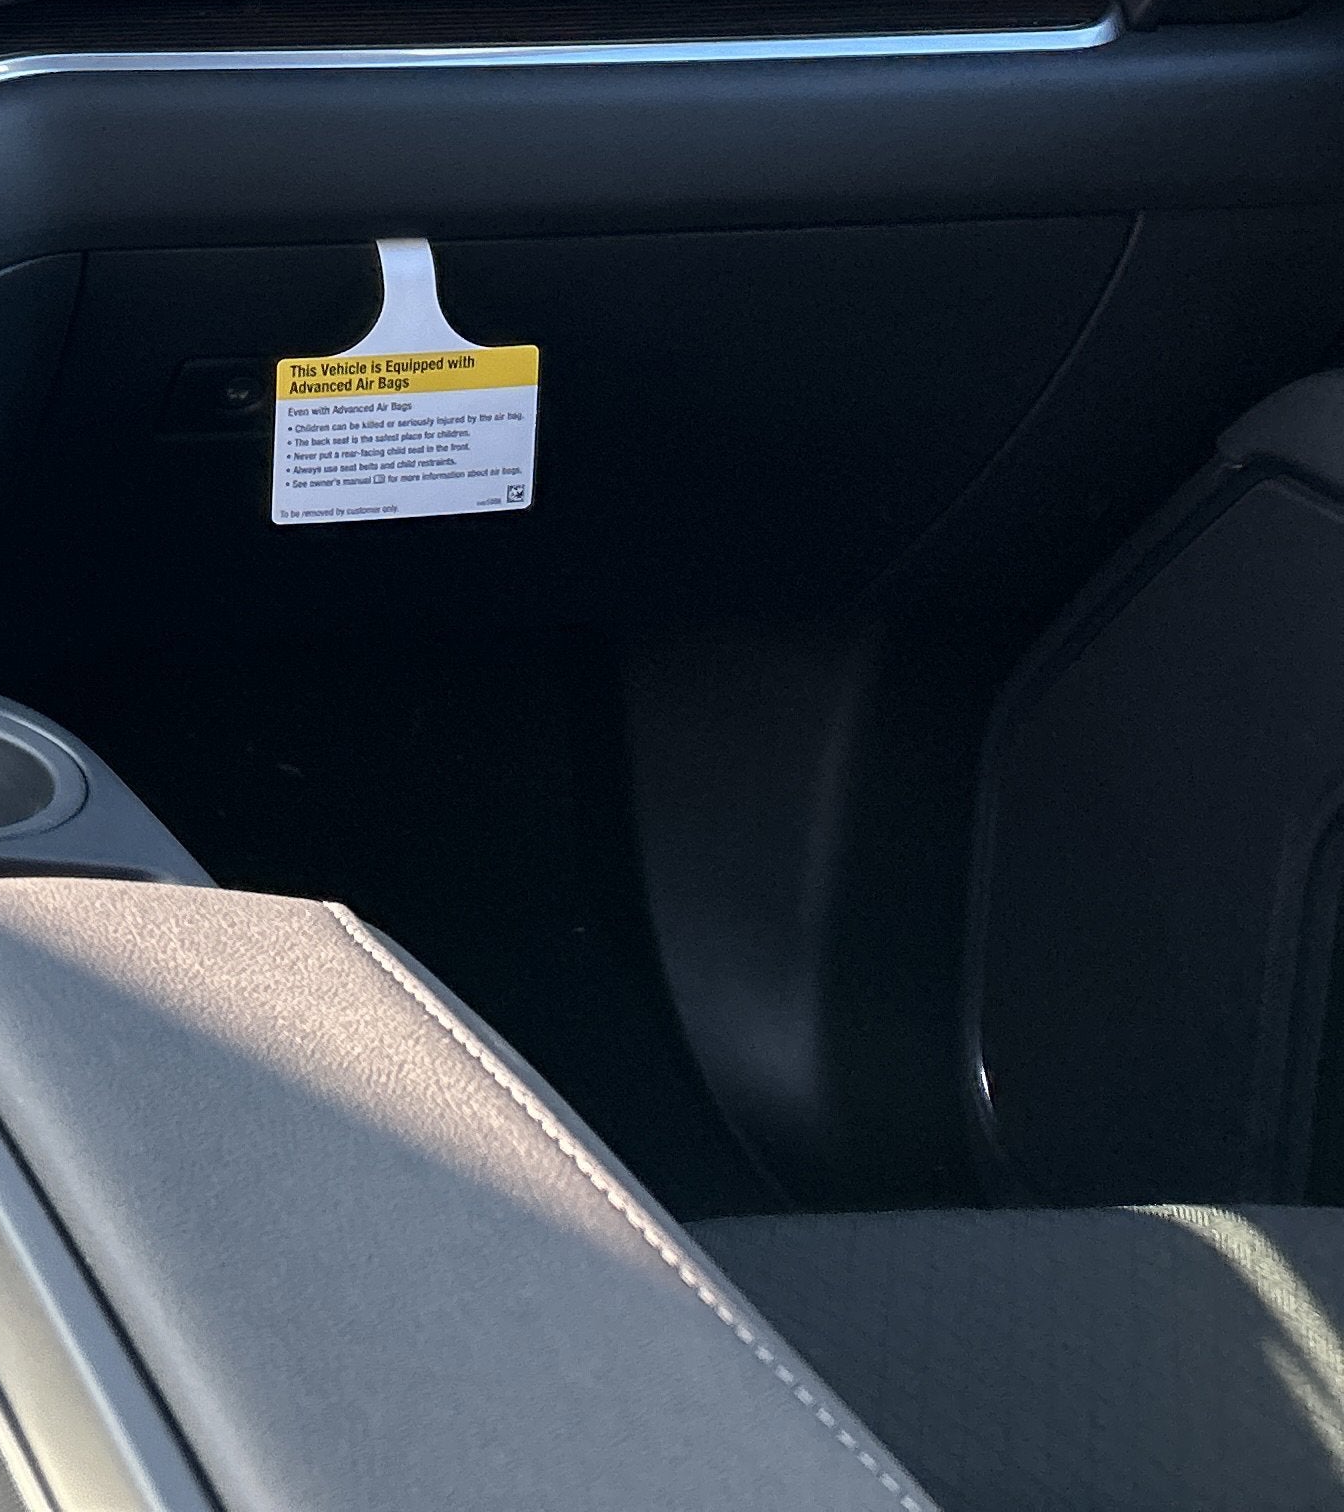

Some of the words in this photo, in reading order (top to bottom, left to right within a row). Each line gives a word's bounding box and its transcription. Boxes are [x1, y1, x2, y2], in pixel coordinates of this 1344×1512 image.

[290, 364, 317, 377] This
[321, 362, 366, 376] Vehicle
[372, 360, 382, 373] is
[386, 357, 443, 374] Equipped
[448, 356, 474, 368] with
[290, 379, 352, 394] Advanced
[356, 378, 374, 390] Air
[378, 377, 410, 391] Bags
[288, 408, 308, 416] Even
[312, 406, 330, 415] with
[332, 404, 374, 414] Advanced
[376, 402, 388, 411] Air
[392, 402, 412, 412] Bags
